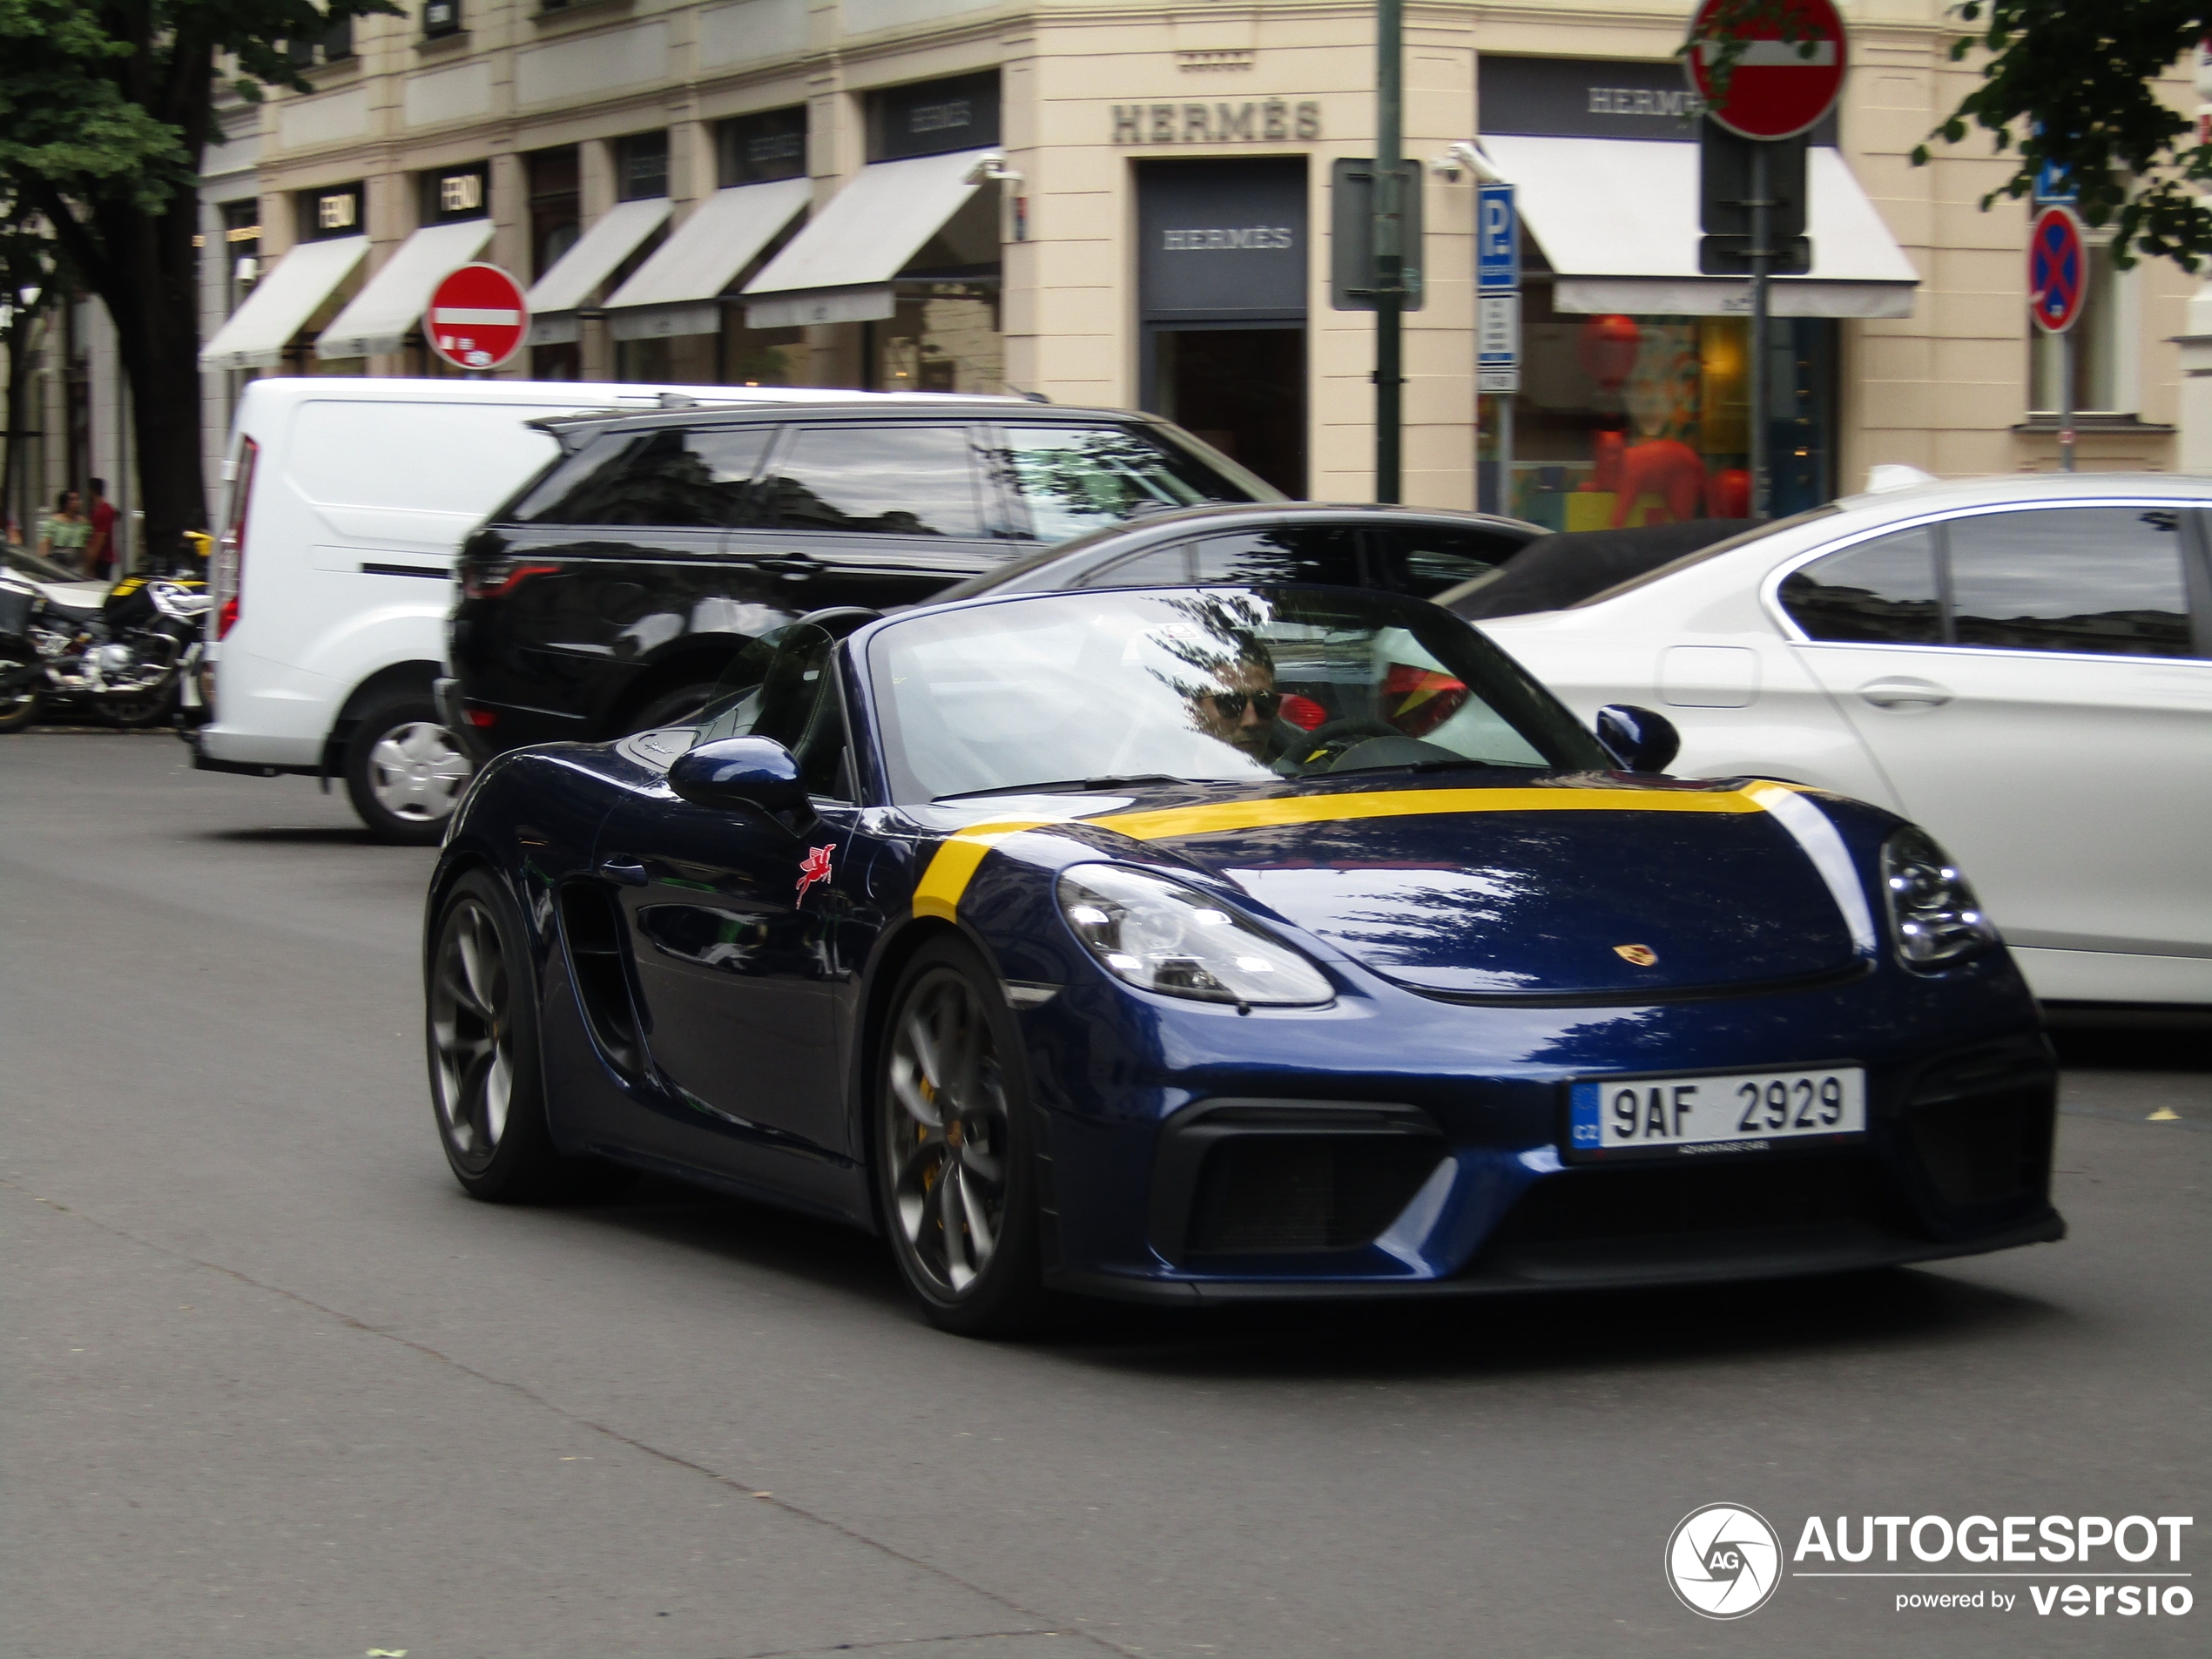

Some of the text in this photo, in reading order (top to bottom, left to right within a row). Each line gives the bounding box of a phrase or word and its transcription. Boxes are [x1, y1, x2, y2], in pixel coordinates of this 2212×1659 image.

[1613, 1076, 1841, 1138] 9AF 2929
[1573, 1123, 1599, 1141] CZ
